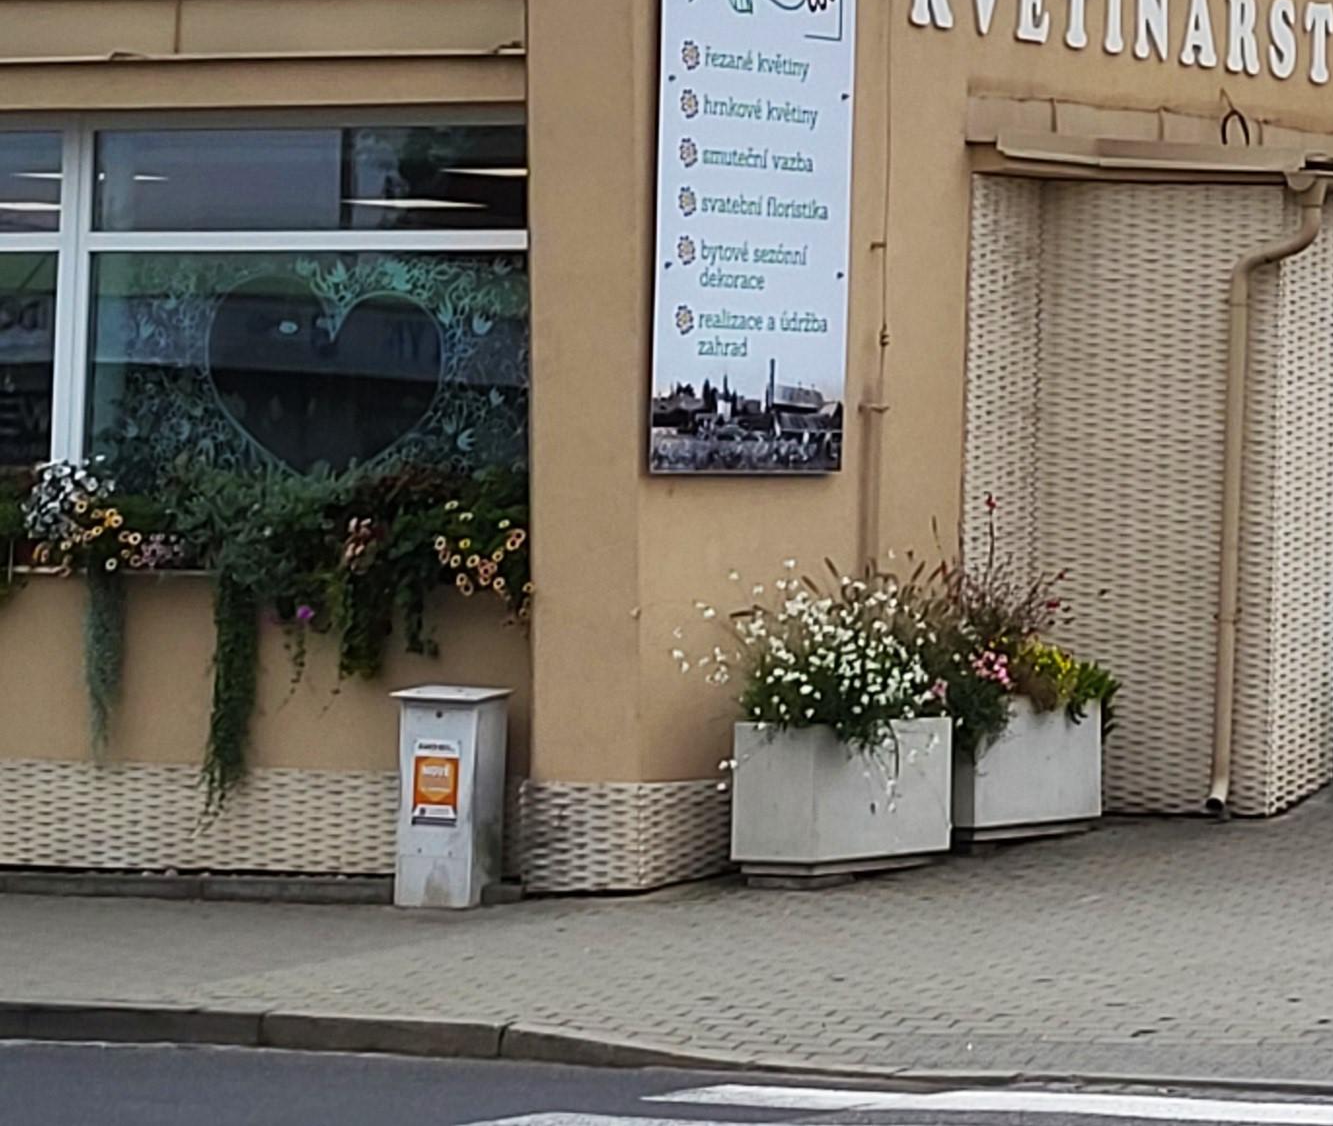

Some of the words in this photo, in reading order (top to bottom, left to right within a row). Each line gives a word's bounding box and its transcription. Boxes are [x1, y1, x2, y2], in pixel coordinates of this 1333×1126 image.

[704, 46, 753, 71] řezané
[757, 52, 810, 82] květiny
[703, 94, 762, 120] hrnkové
[766, 100, 818, 130] květiny
[702, 148, 769, 169] smuteční
[772, 152, 813, 173] vazba
[701, 194, 763, 216] svatební
[767, 196, 829, 221] floristika
[701, 239, 749, 266] bytové
[753, 244, 808, 265] sezónní
[700, 267, 765, 290] dekorace
[698, 309, 764, 331] realizace
[767, 315, 776, 331] a
[780, 311, 828, 333] údržba
[698, 336, 748, 357] zahrad
